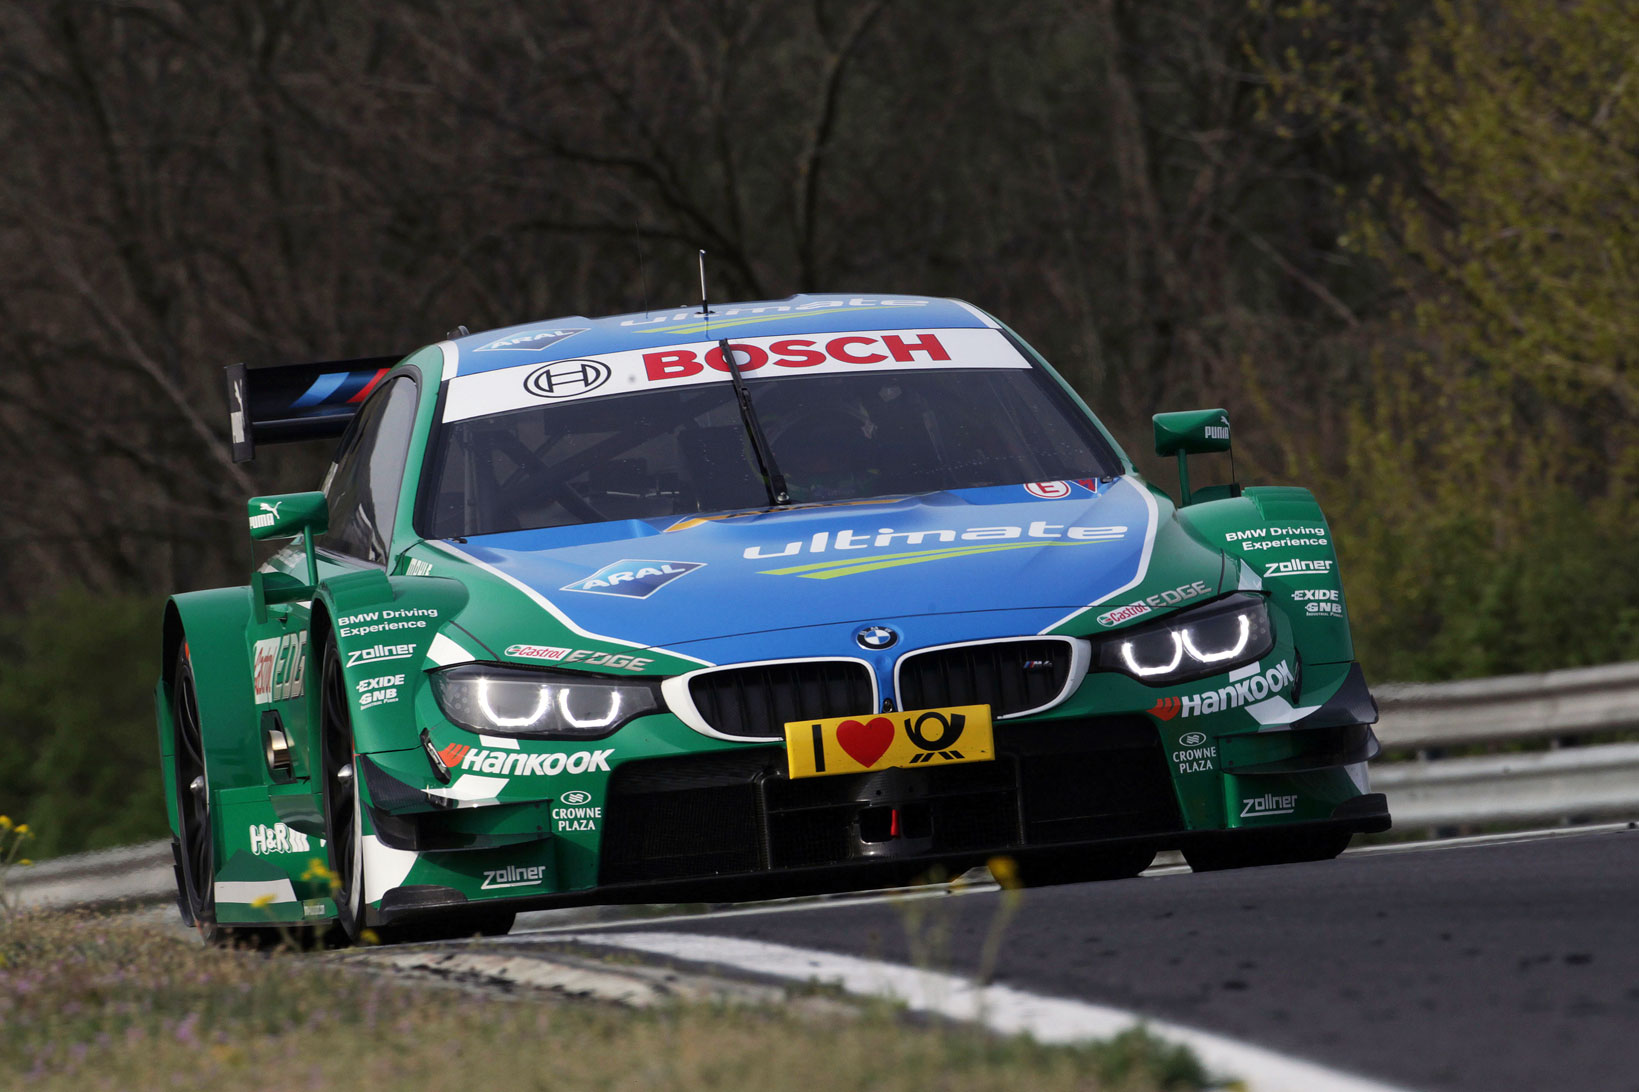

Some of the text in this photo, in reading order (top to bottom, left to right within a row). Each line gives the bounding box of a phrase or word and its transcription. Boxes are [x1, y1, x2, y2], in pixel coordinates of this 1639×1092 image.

[491, 329, 575, 349] ARAL
[641, 333, 952, 382] BOSCH
[1204, 425, 1230, 439] PUMA
[742, 519, 1129, 561] ultimate
[1225, 526, 1325, 541] BMW Driving
[1242, 537, 1328, 551] Experience
[582, 562, 686, 590] ARAL
[1110, 580, 1213, 623] Castrol EDGE
[1291, 589, 1339, 600] EXIDE
[1304, 602, 1342, 613] GNB
[338, 607, 439, 627] BMW Driving
[340, 620, 427, 637] Experience
[518, 645, 656, 672] Castrol EDGE
[356, 674, 405, 692] EXIDE
[359, 688, 397, 704] GNB
[811, 723, 826, 772] I
[1172, 746, 1217, 763] CROWNE
[1179, 759, 1213, 774] PLAZA
[552, 807, 602, 820] CROWNE
[558, 820, 596, 832] PLAZA
[249, 822, 293, 856] H&R
